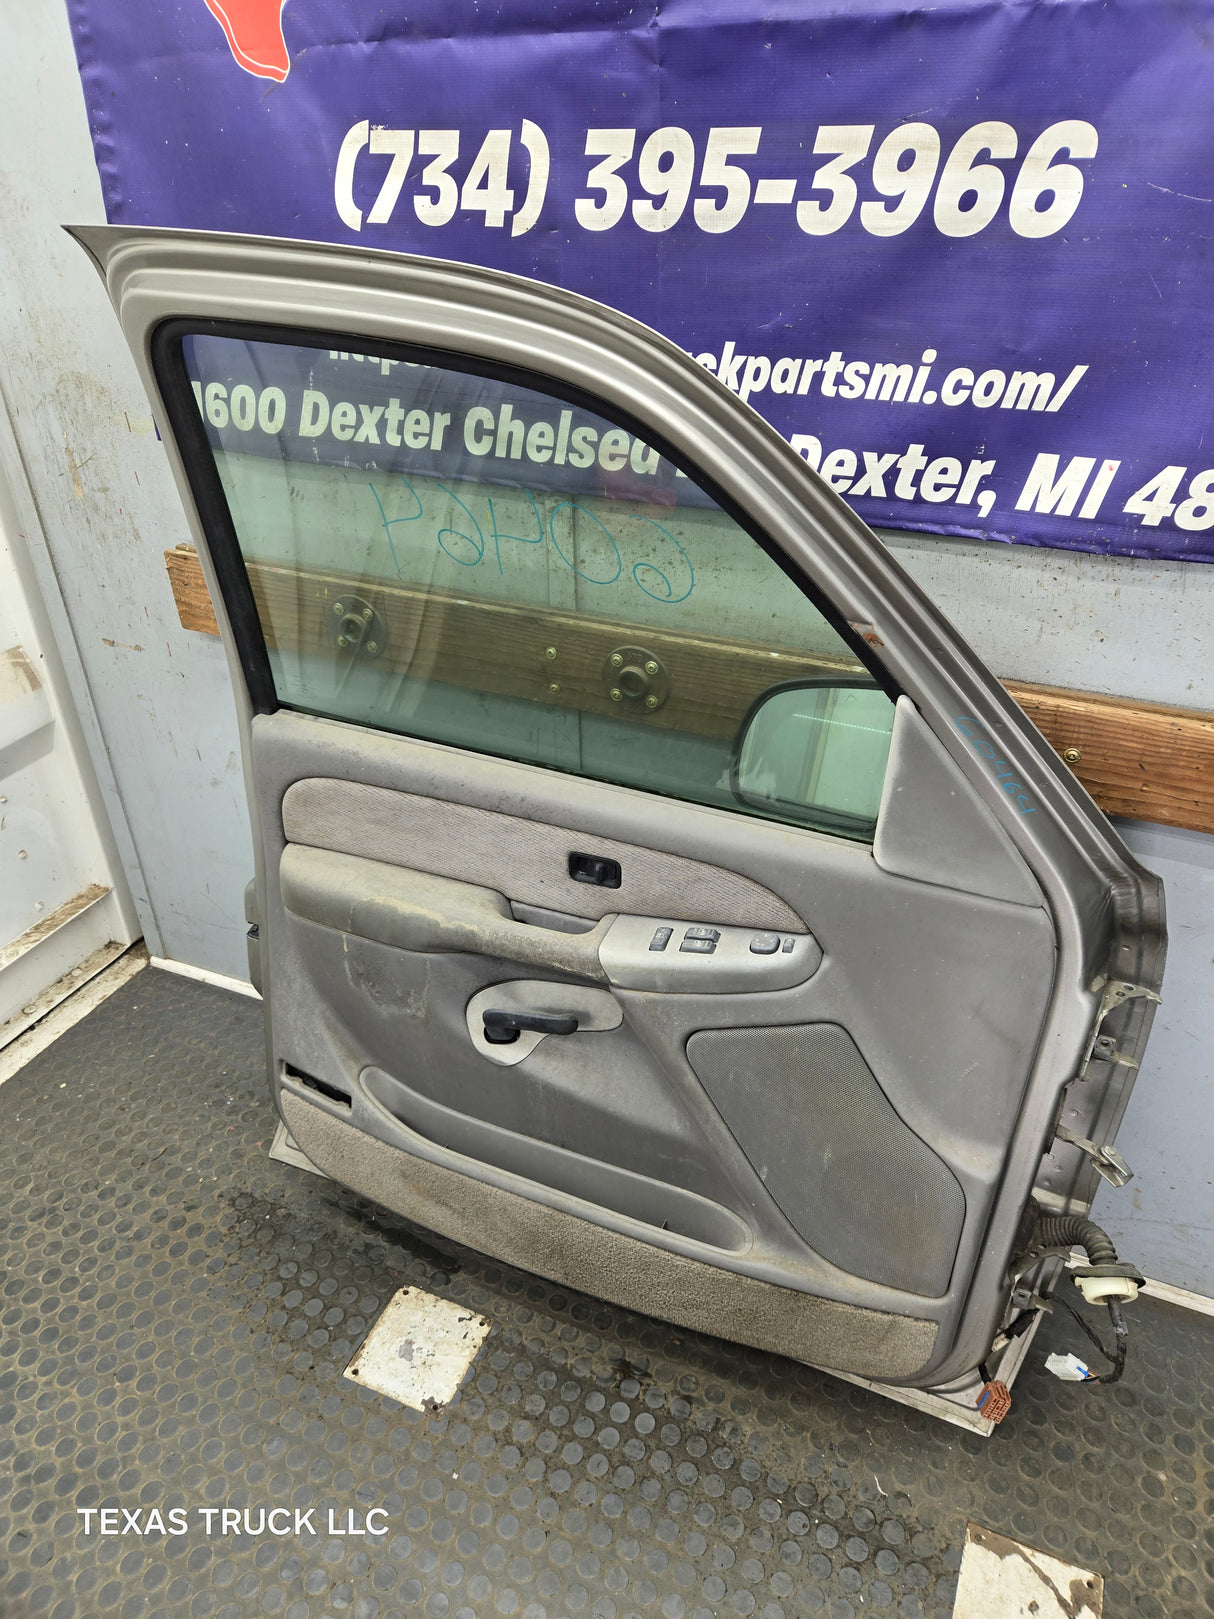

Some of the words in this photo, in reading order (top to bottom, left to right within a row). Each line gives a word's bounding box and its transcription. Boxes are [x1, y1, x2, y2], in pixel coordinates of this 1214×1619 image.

[334, 119, 549, 237] (734)
[574, 120, 1099, 238] 395-3966
[687, 341, 1090, 412] ckpartsmi.com/
[299, 389, 451, 451] Dexter
[463, 404, 660, 476] Chelsea
[790, 434, 997, 517] Dexter,
[1014, 452, 1122, 519] MI
